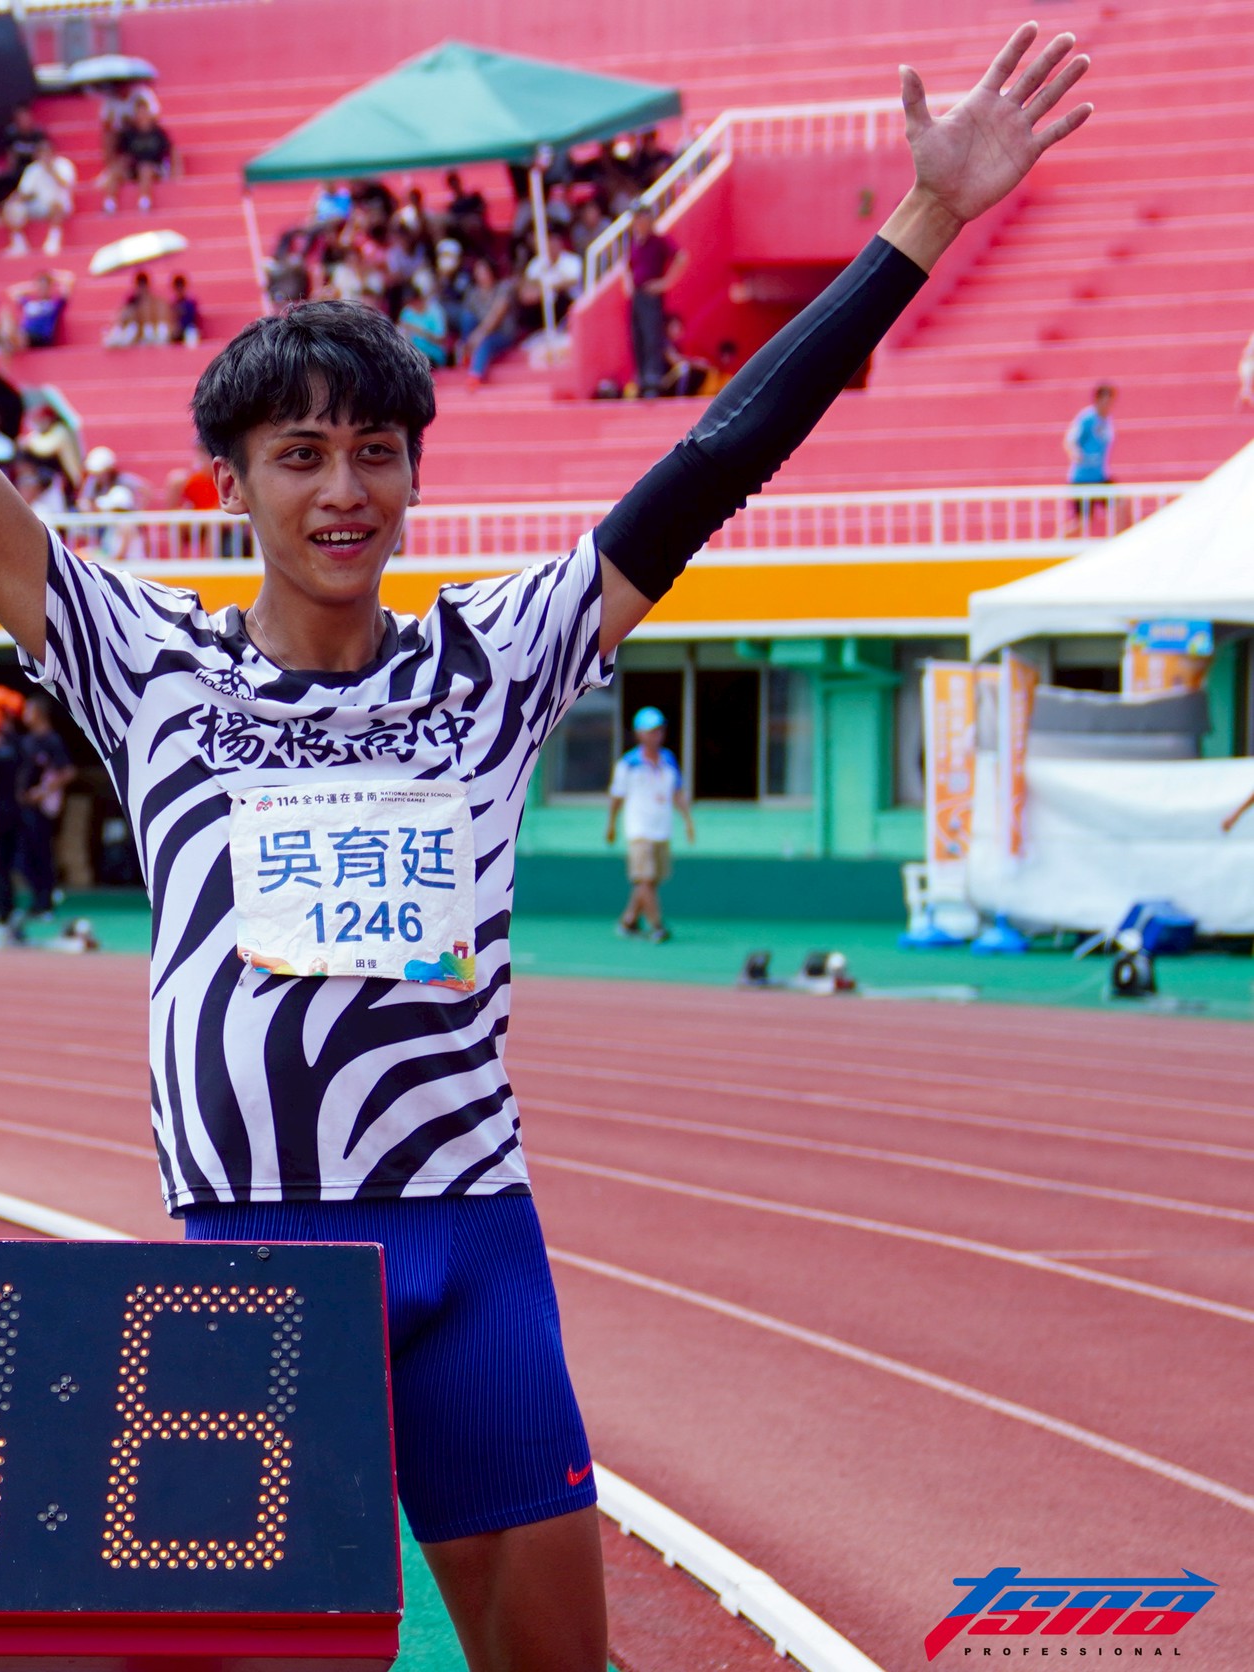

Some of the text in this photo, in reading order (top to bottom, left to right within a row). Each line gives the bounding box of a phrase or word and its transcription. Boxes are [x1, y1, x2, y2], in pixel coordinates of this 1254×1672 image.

[277, 791, 377, 807] 114 全中運在臺南
[257, 826, 457, 894] 吳育廷
[305, 901, 424, 944] 1246
[355, 958, 378, 969] 田徑
